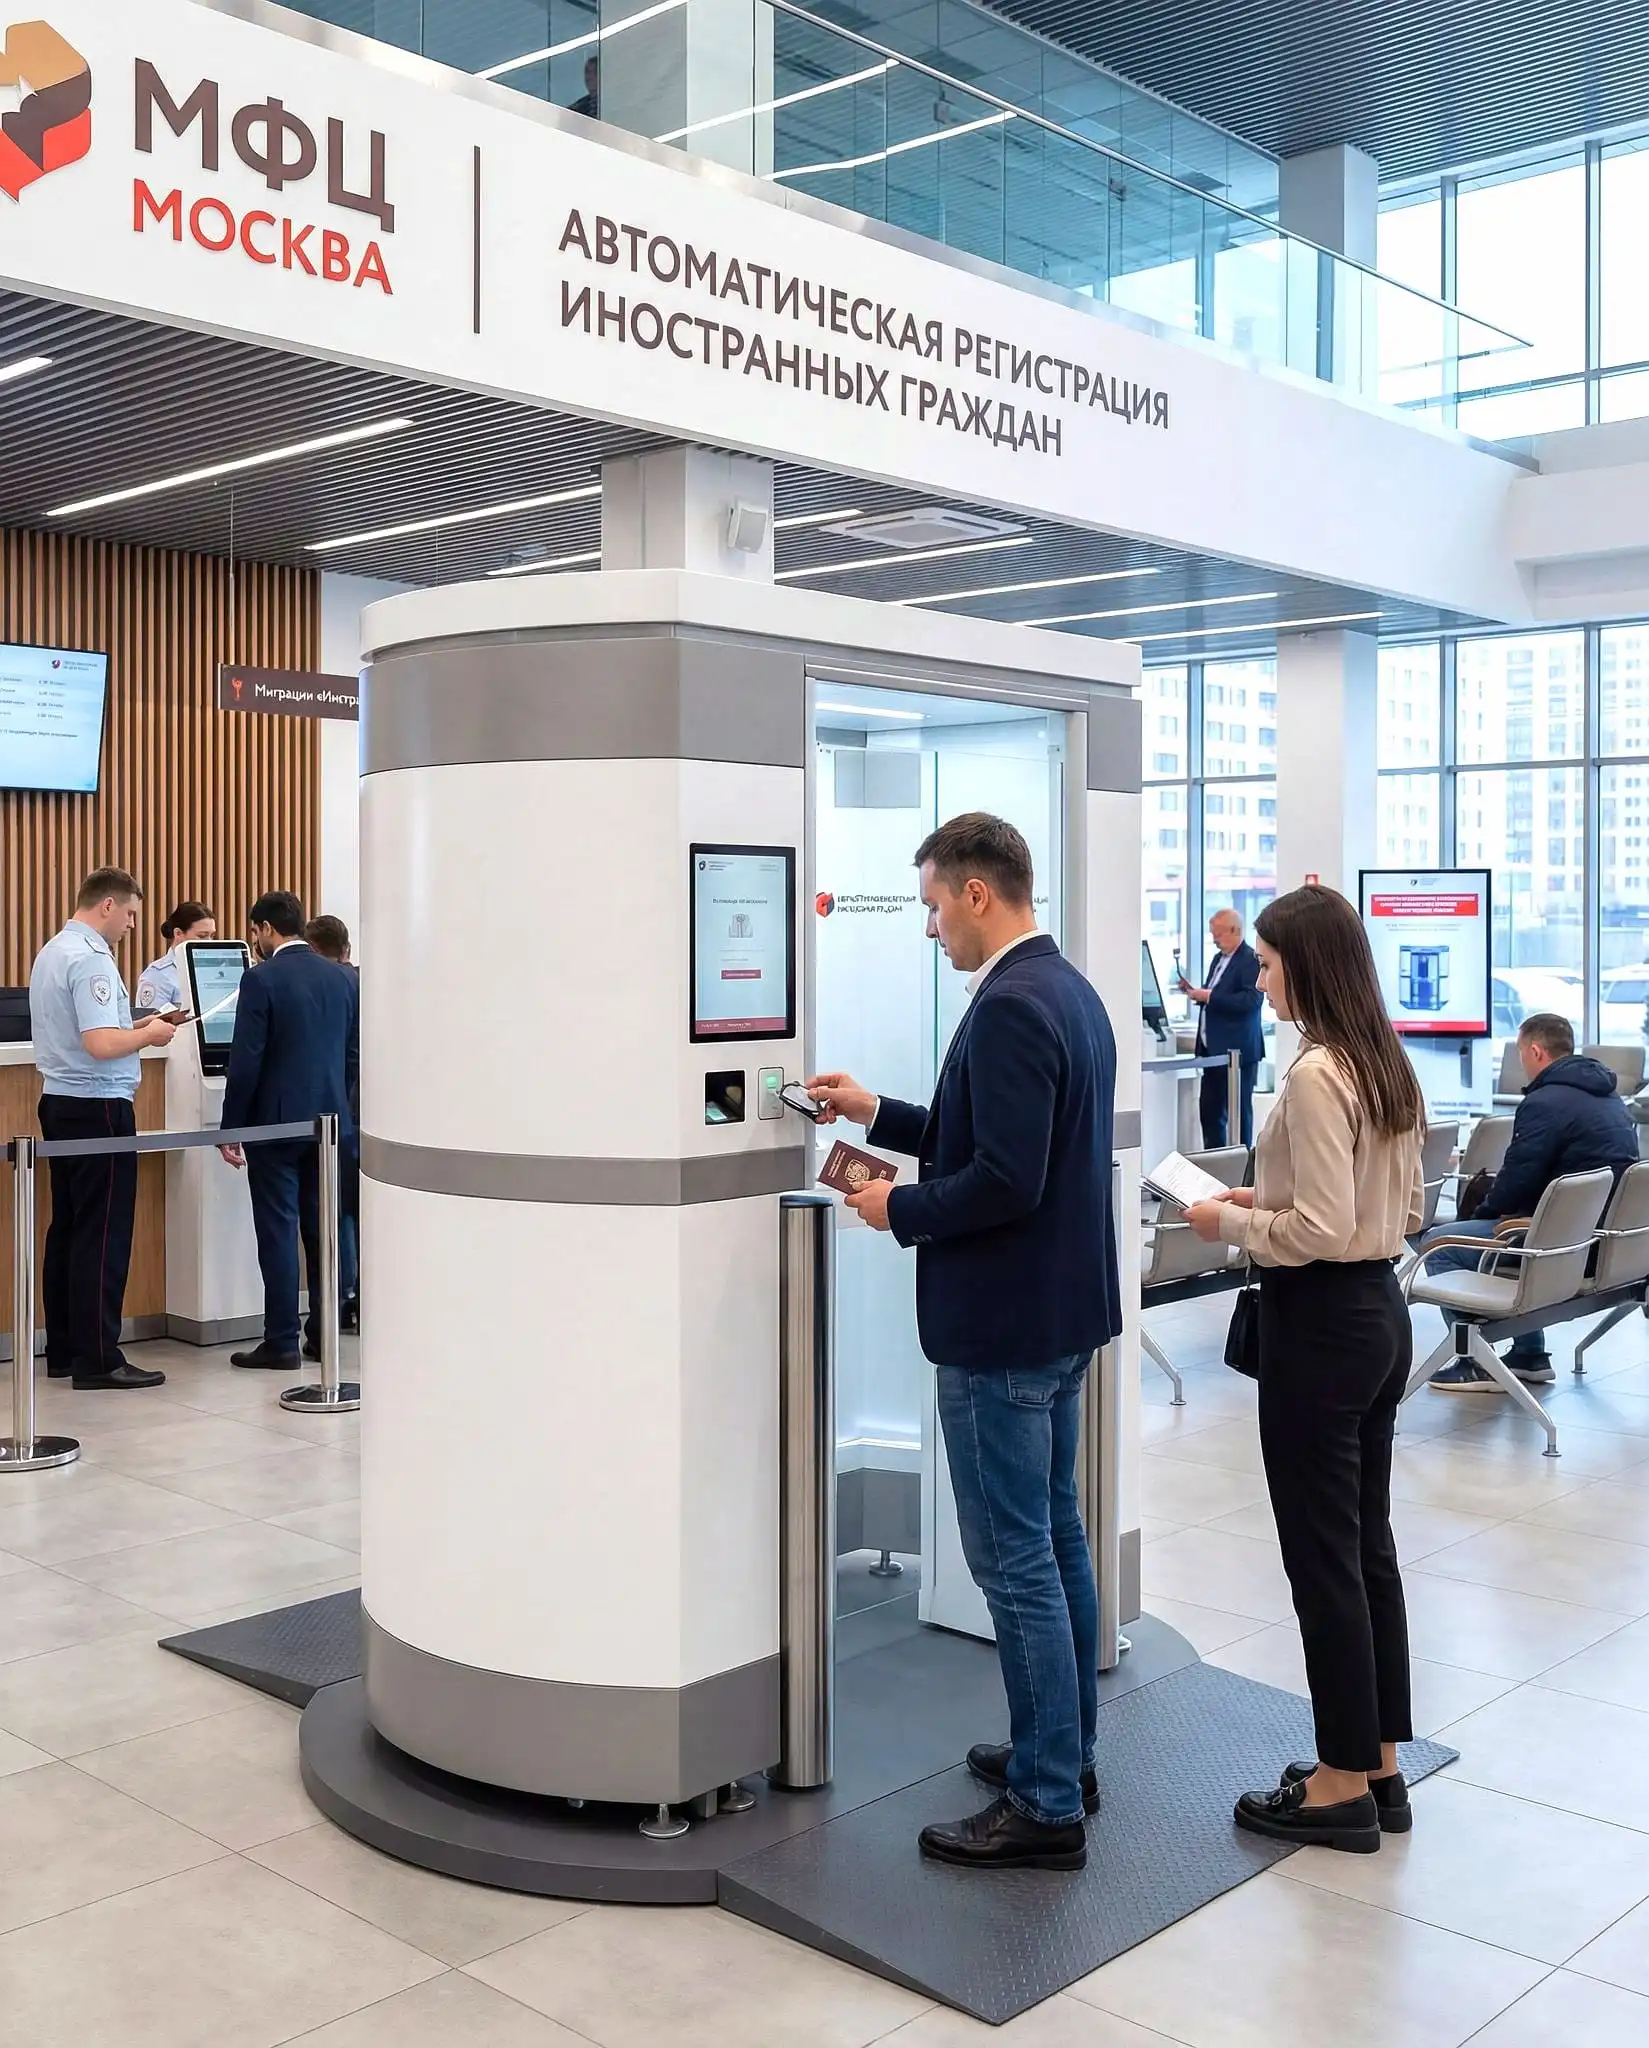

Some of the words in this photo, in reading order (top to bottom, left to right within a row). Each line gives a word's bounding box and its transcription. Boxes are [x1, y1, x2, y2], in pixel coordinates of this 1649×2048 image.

[135, 58, 395, 234] МФЦ
[134, 179, 394, 295] МОСКВА
[558, 209, 943, 362] АВТОМАТИЧЕСКАЯ
[956, 328, 1169, 430] РЕГИСТРАЦИЯ
[561, 280, 890, 412] ИНОСТРАННЫХ
[902, 375, 1061, 457] ГРАЖДАН
[254, 683, 313, 702] Миграции
